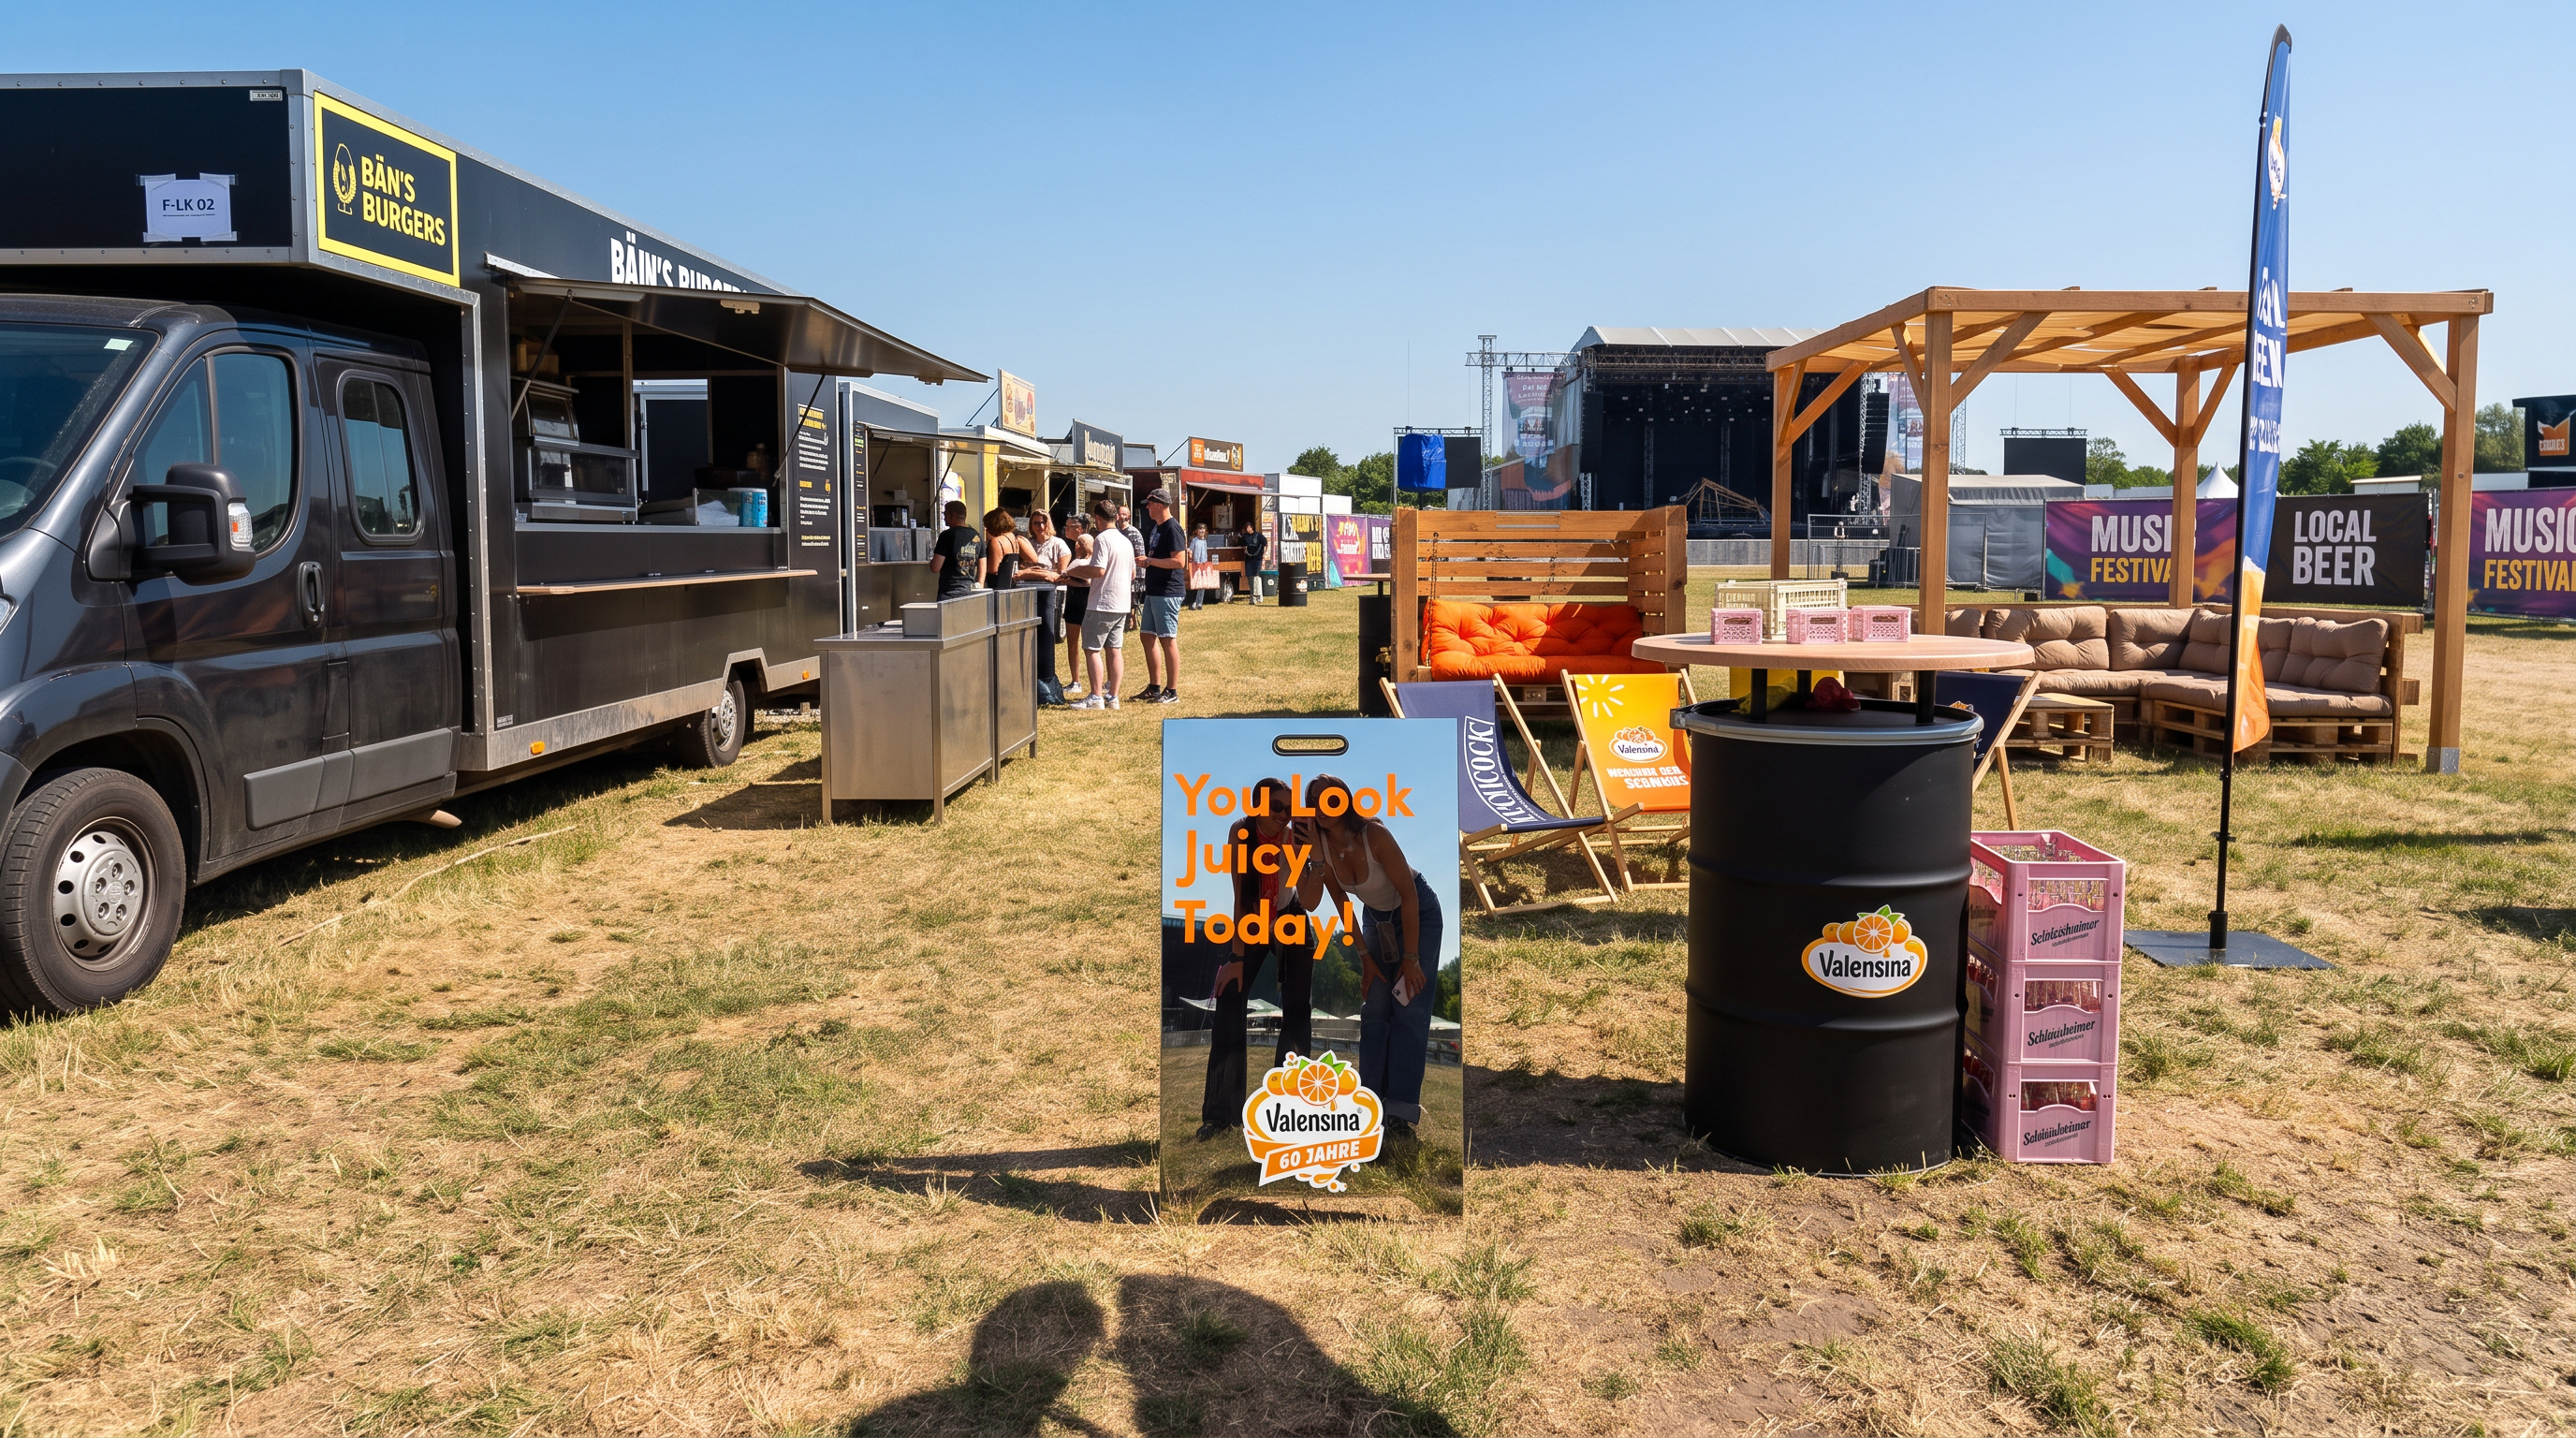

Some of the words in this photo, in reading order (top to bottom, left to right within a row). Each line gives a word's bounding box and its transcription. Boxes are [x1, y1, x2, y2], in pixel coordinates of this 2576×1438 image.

[361, 154, 416, 203] BÄN'S
[162, 198, 194, 212] F-LK
[197, 198, 215, 211] 02
[362, 190, 446, 246] BURGERS
[2091, 515, 2173, 552] MUSI
[2294, 509, 2378, 543] LOCAL
[2090, 557, 2173, 583] FESTIVA
[2292, 546, 2376, 586] BEER
[1173, 773, 1270, 817] You
[1291, 772, 1416, 817] Look
[1175, 828, 1313, 888] Juicy
[1174, 898, 1354, 961] Today!
[1819, 949, 1911, 978] Valensina
[1266, 1102, 1360, 1133] Valensina
[1279, 1150, 1301, 1169] 60
[1306, 1140, 1360, 1164] JAHRE
